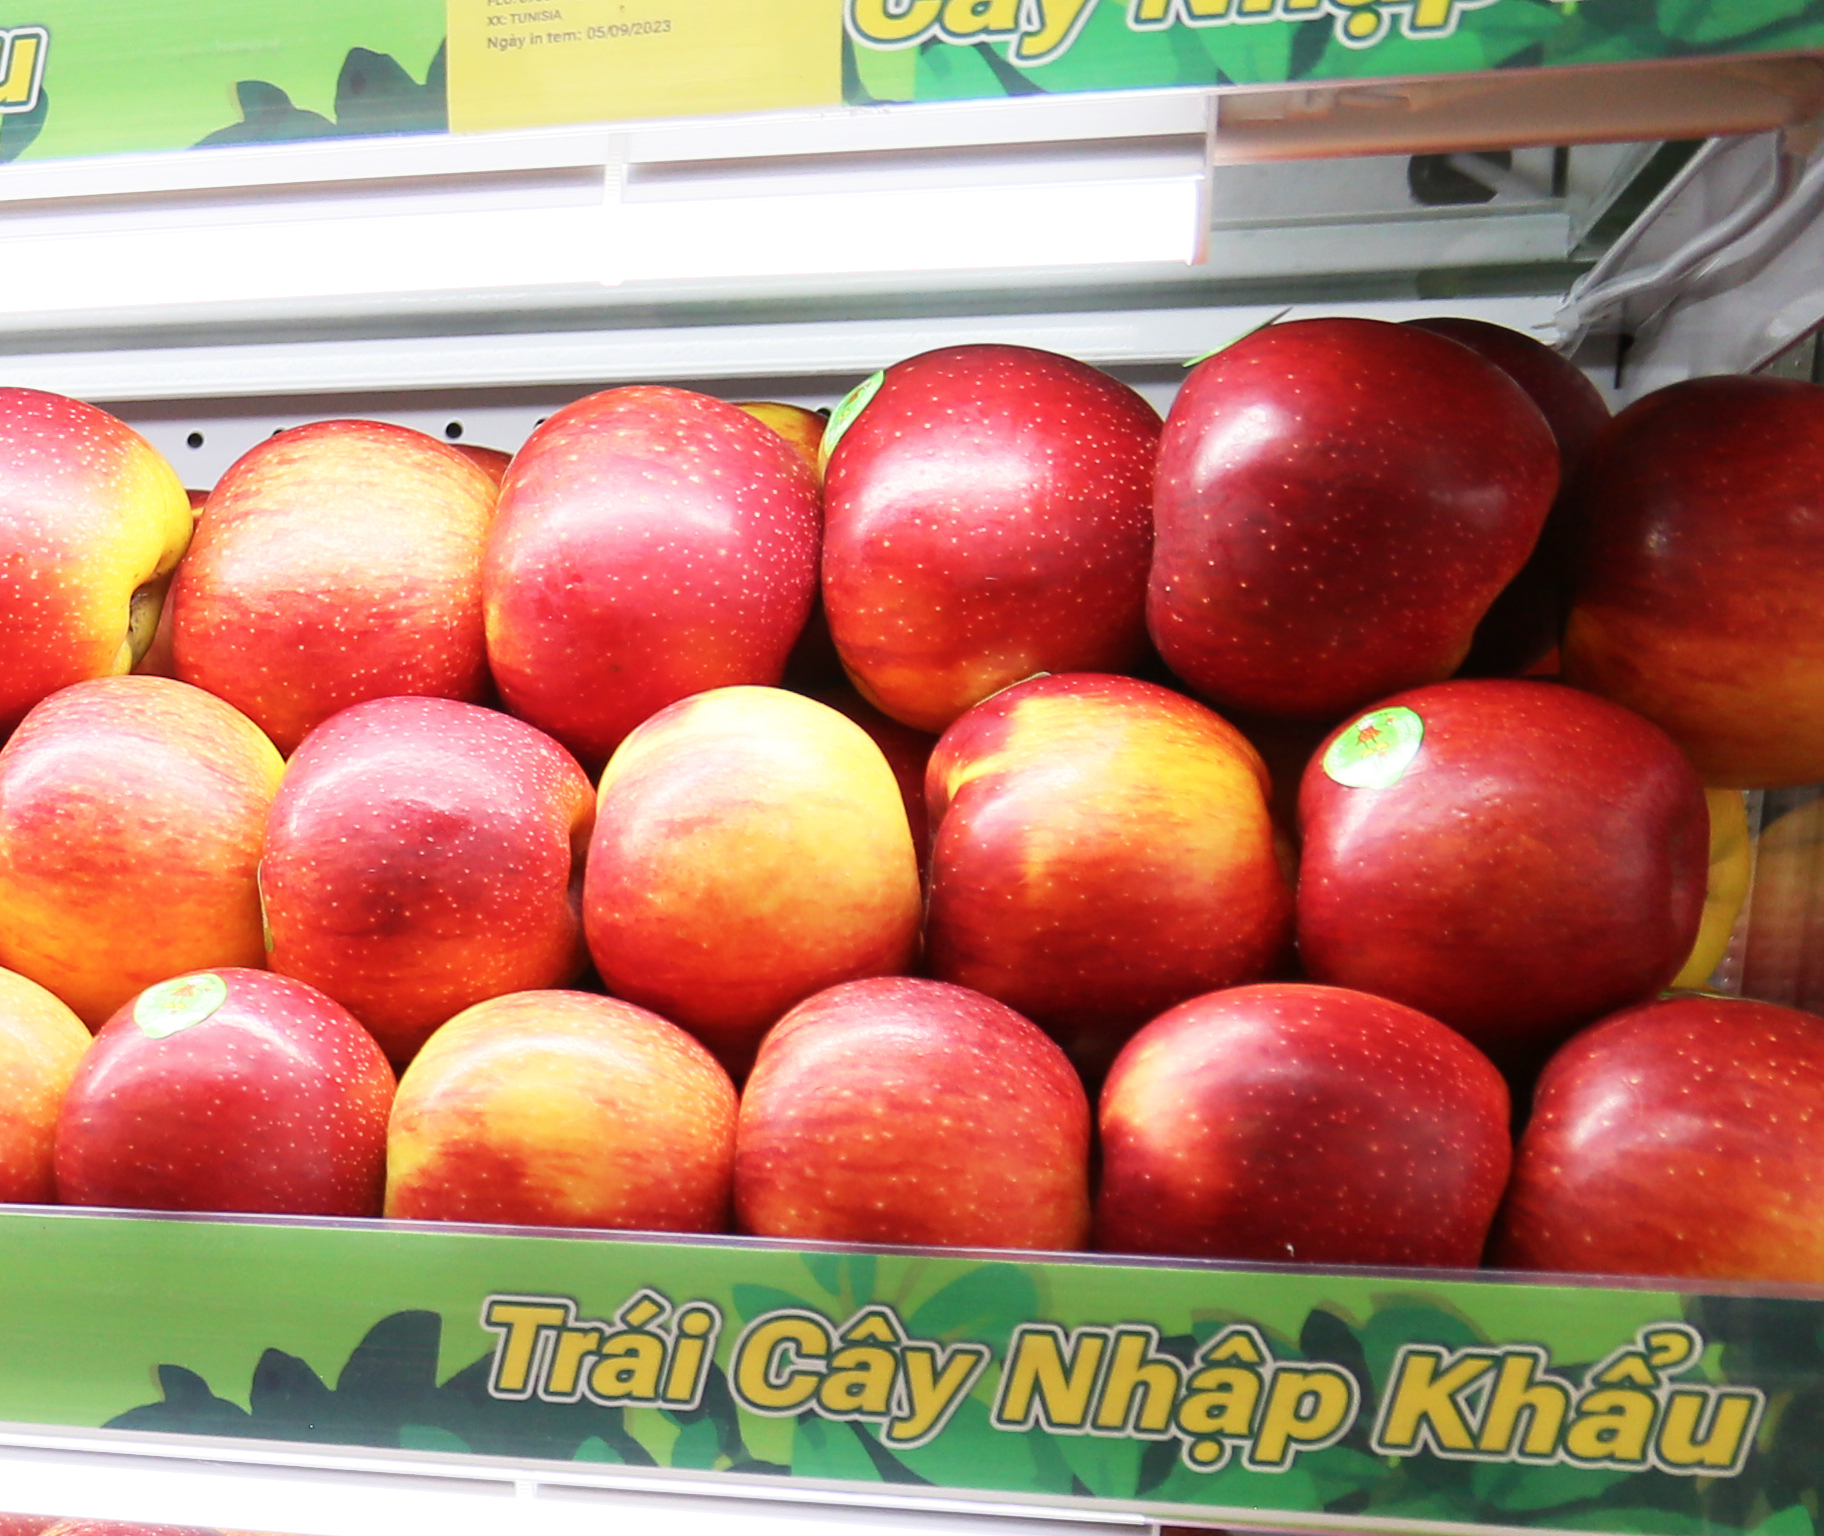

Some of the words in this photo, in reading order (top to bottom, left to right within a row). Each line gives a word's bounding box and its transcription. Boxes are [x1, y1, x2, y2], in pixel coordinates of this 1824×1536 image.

[510, 10, 562, 23] TUNISIA
[487, 34, 525, 50] Ngày
[530, 32, 542, 44] in
[547, 29, 582, 43] tem:
[587, 20, 672, 40] 05/09/2023
[483, 1288, 719, 1413] Trái
[729, 1306, 991, 1448] Cây
[998, 1322, 1361, 1476] Nhập
[1372, 1324, 1760, 1480] Khẩu
